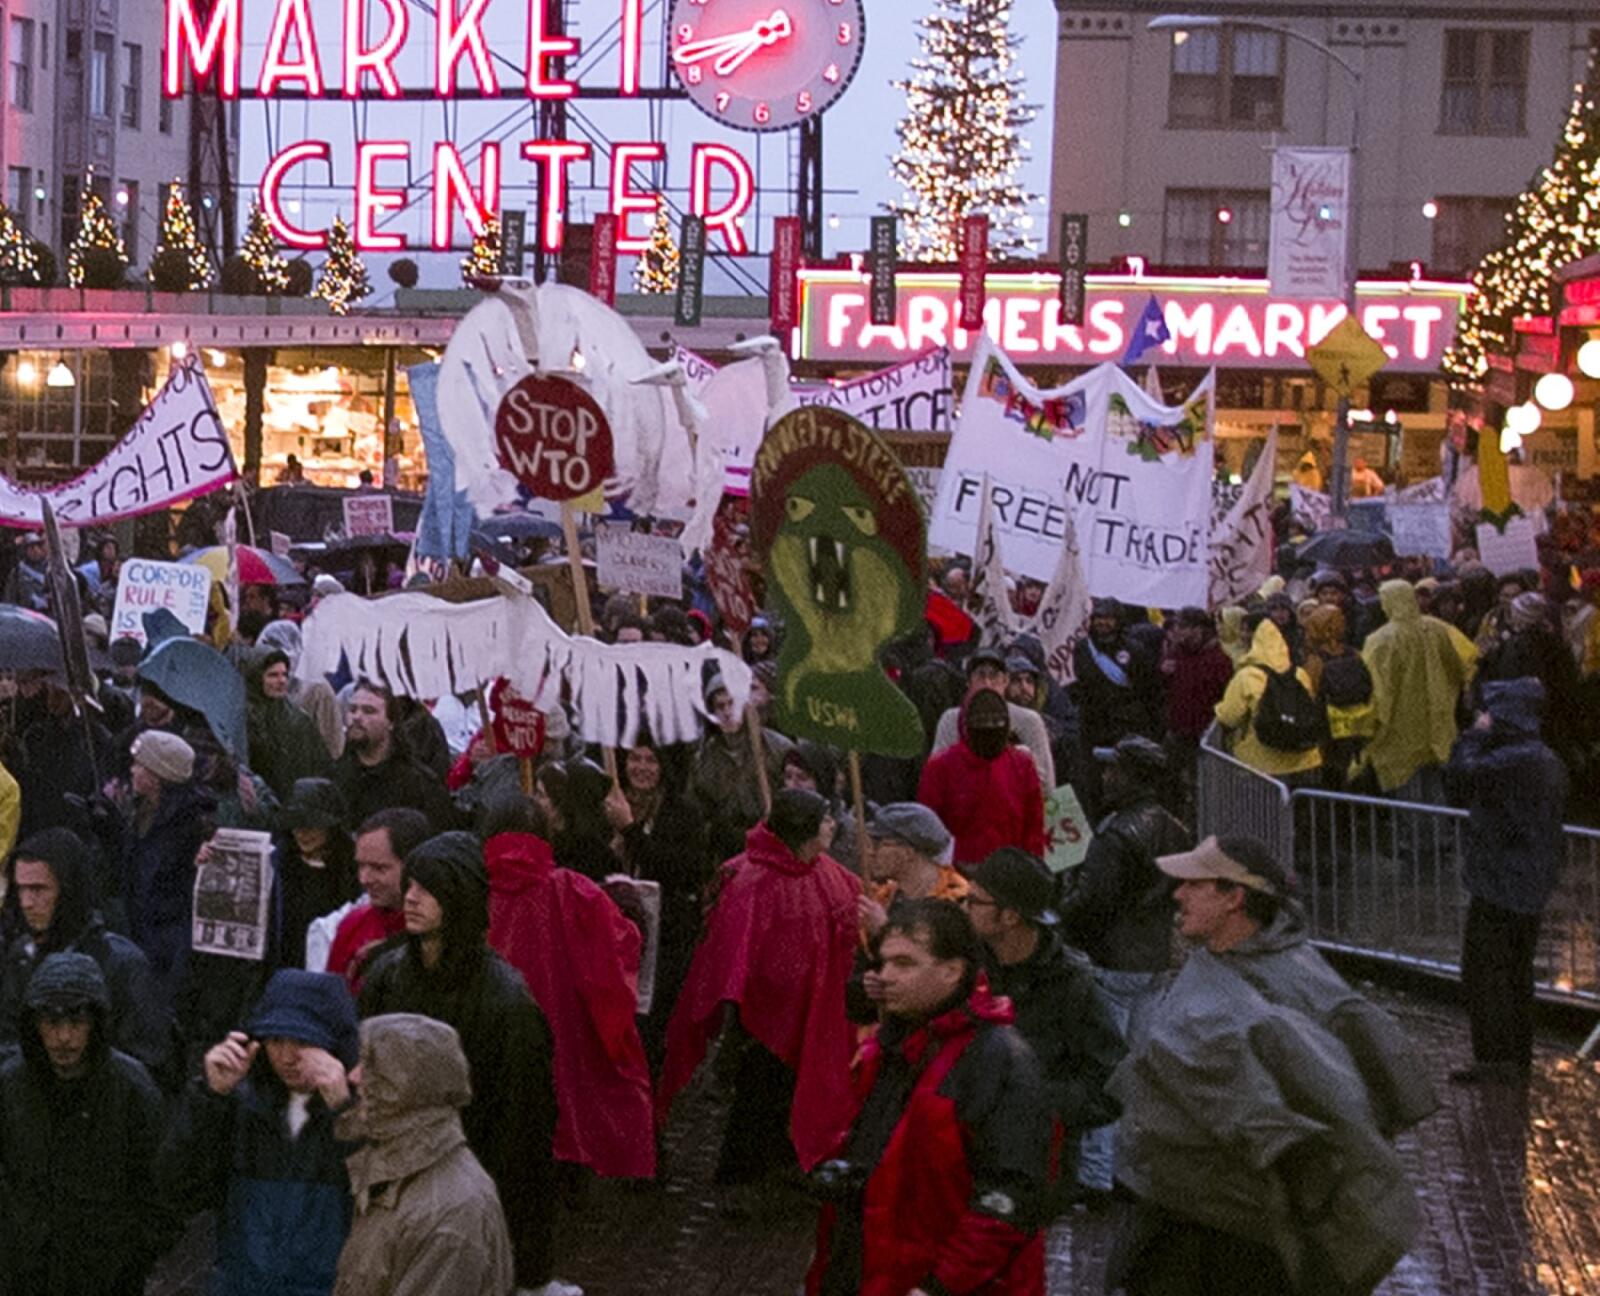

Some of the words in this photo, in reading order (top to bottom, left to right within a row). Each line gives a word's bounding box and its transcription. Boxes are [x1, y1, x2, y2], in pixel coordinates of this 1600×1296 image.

[260, 140, 755, 253] CENTER
[507, 390, 598, 445] STOP
[502, 440, 591, 493] WTO
[1064, 461, 1131, 512] NOT
[954, 477, 1067, 540] FREE
[1096, 516, 1201, 567] TRADE
[124, 584, 177, 609] RULE
[503, 722, 538, 750] WTO
